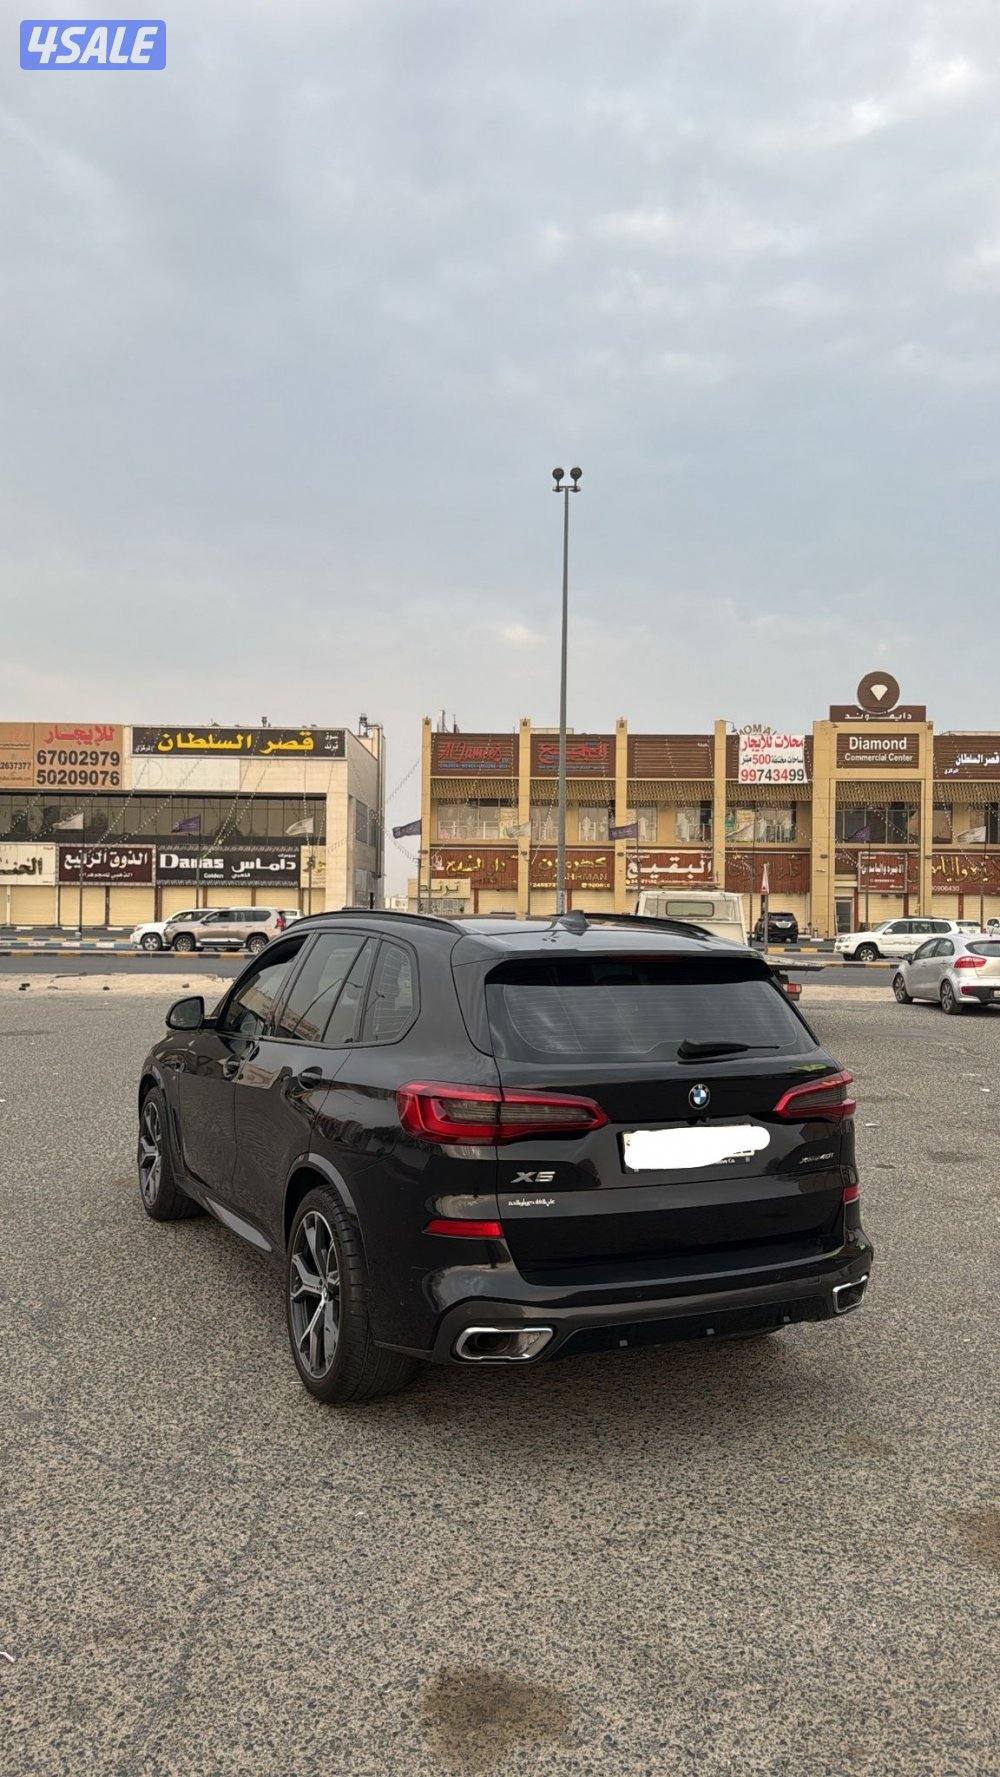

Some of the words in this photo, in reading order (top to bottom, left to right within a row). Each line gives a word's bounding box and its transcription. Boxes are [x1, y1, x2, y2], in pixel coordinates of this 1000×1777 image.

[157, 733, 252, 752] السلطان
[259, 732, 313, 754] قصر
[849, 737, 907, 750] Diamond
[37, 750, 120, 766] 67002979
[752, 754, 771, 765] 500
[844, 753, 887, 762] Commercial
[888, 753, 913, 762] Center
[956, 753, 983, 766] السلطان
[37, 770, 120, 785] 50209076
[741, 769, 804, 781] 99743499
[64, 849, 107, 869] الرفيع
[109, 850, 148, 868] الذوق
[231, 858, 297, 873] داماس
[627, 857, 712, 879] البقيع
[510, 1171, 556, 1183] X5
